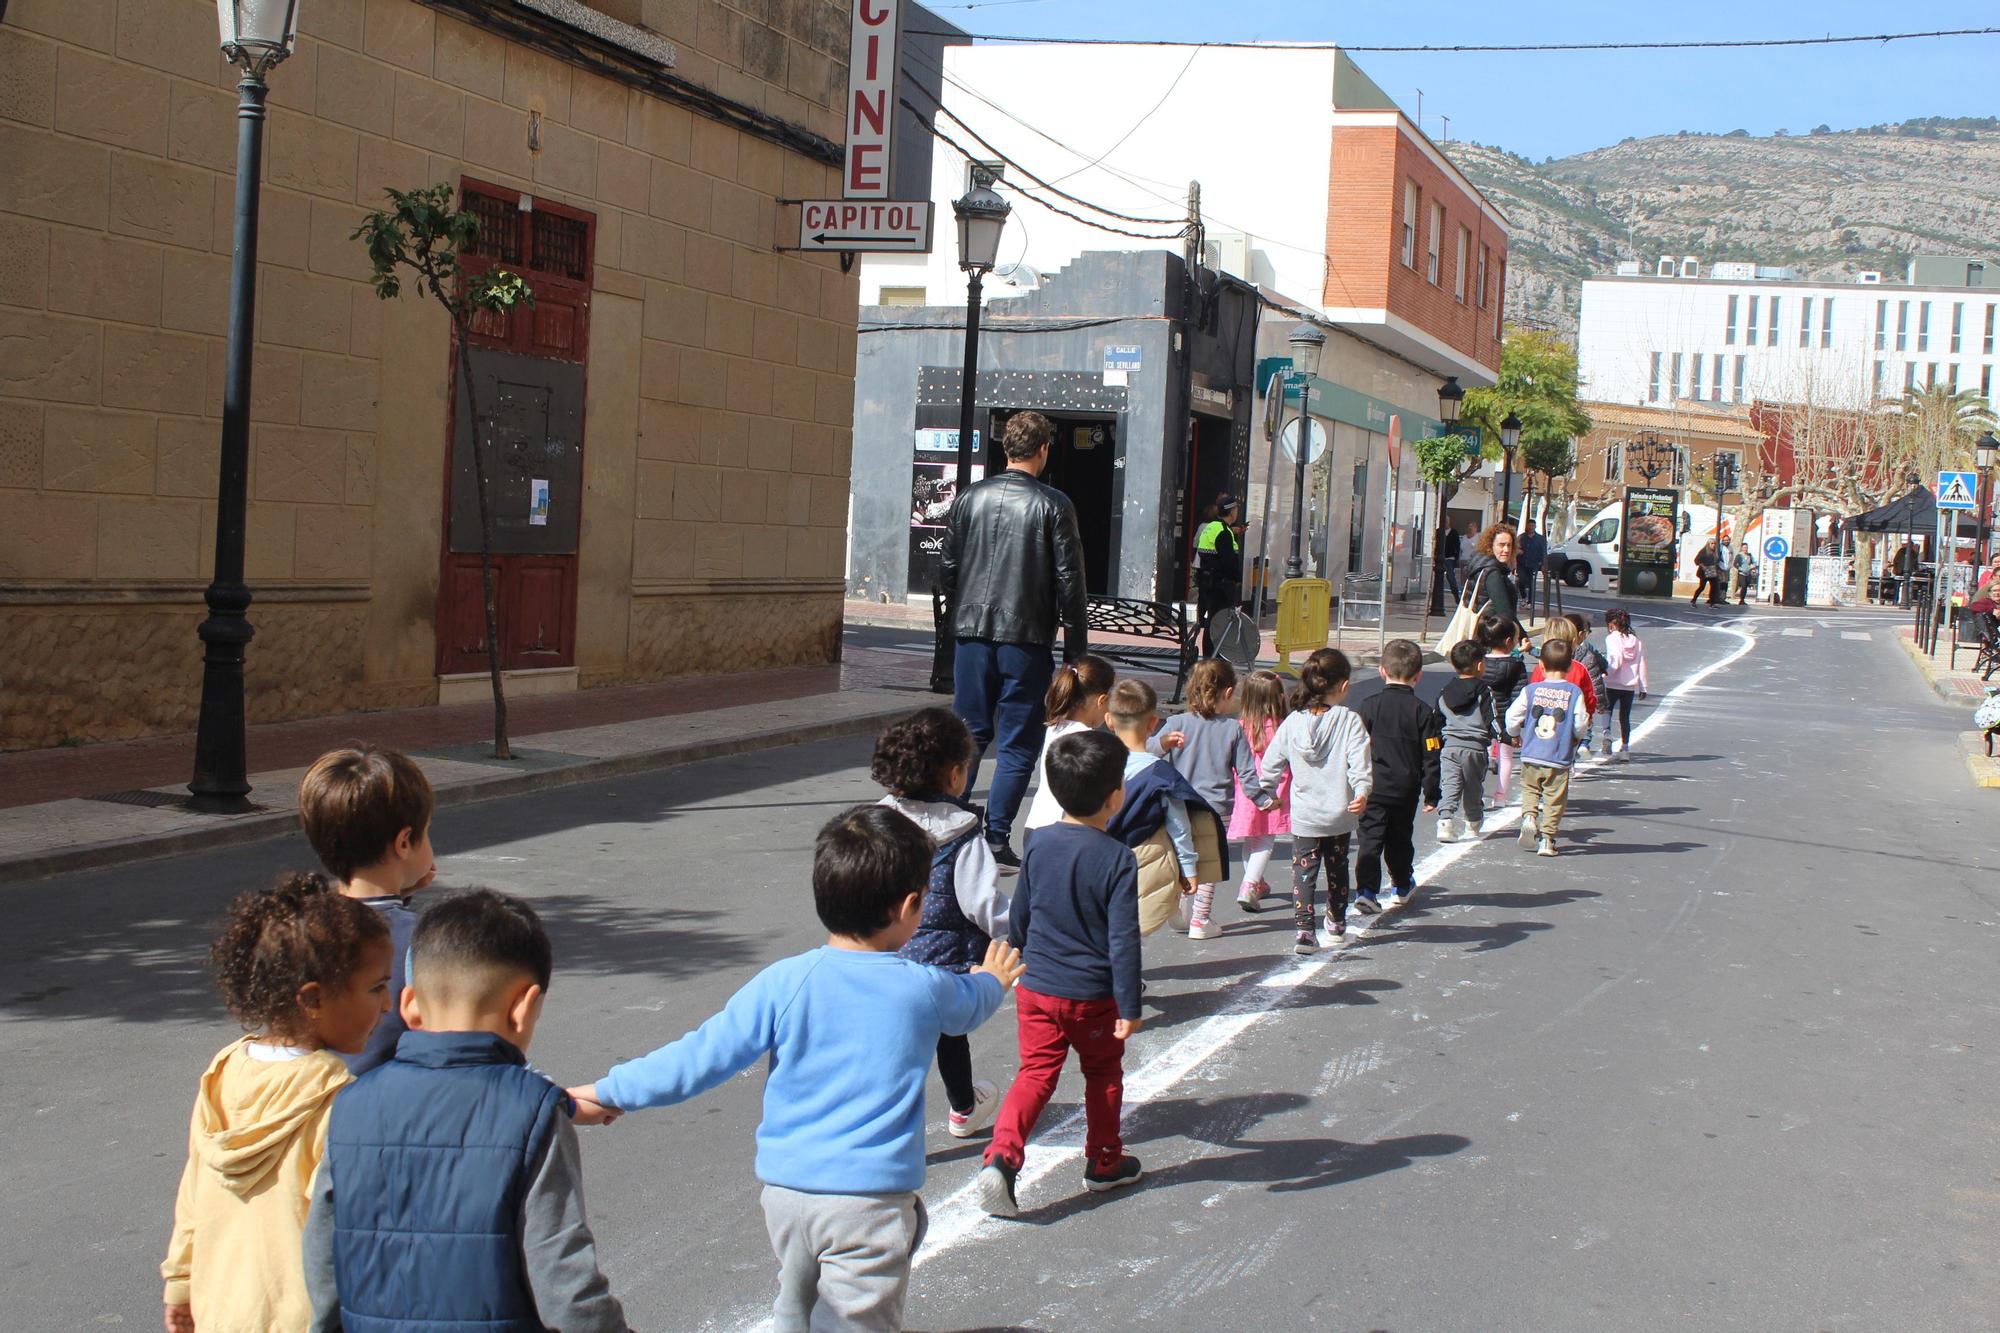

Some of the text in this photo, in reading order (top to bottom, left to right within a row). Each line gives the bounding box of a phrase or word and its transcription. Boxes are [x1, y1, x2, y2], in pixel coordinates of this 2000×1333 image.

[850, 0, 890, 190] CINE
[806, 206, 921, 231] CAPITOL
[1115, 346, 1137, 354] CALLE
[1535, 687, 1571, 699] MICKEY
[1533, 697, 1569, 710] MOUSE
